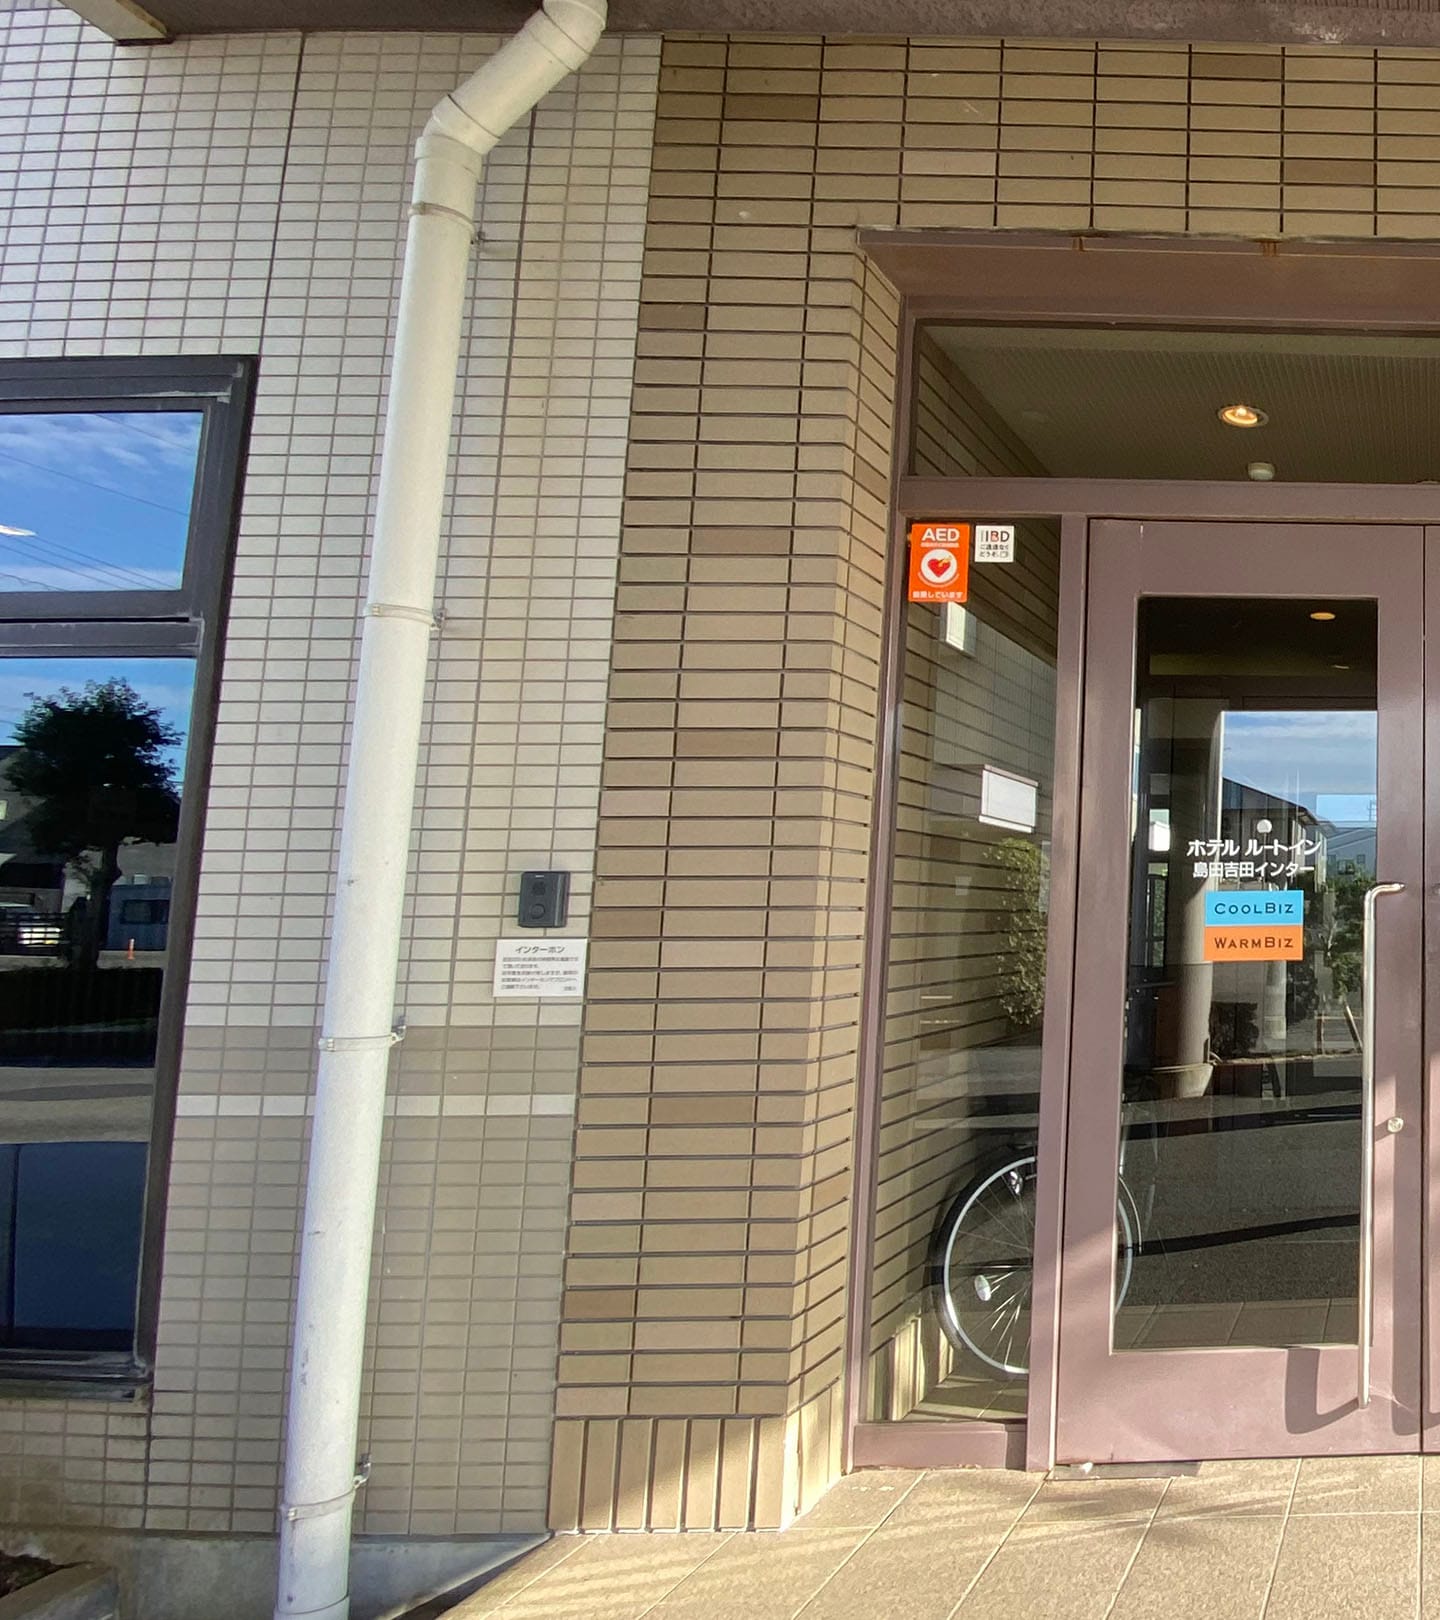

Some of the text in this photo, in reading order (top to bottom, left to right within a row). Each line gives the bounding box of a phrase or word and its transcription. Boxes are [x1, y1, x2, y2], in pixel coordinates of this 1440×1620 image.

[921, 528, 960, 542] AED
[912, 591, 963, 599] しています
[1186, 839, 1322, 857] ホテル ルートイン
[1192, 861, 1315, 878] 島田吉田インター
[515, 946, 565, 954] インターホン
